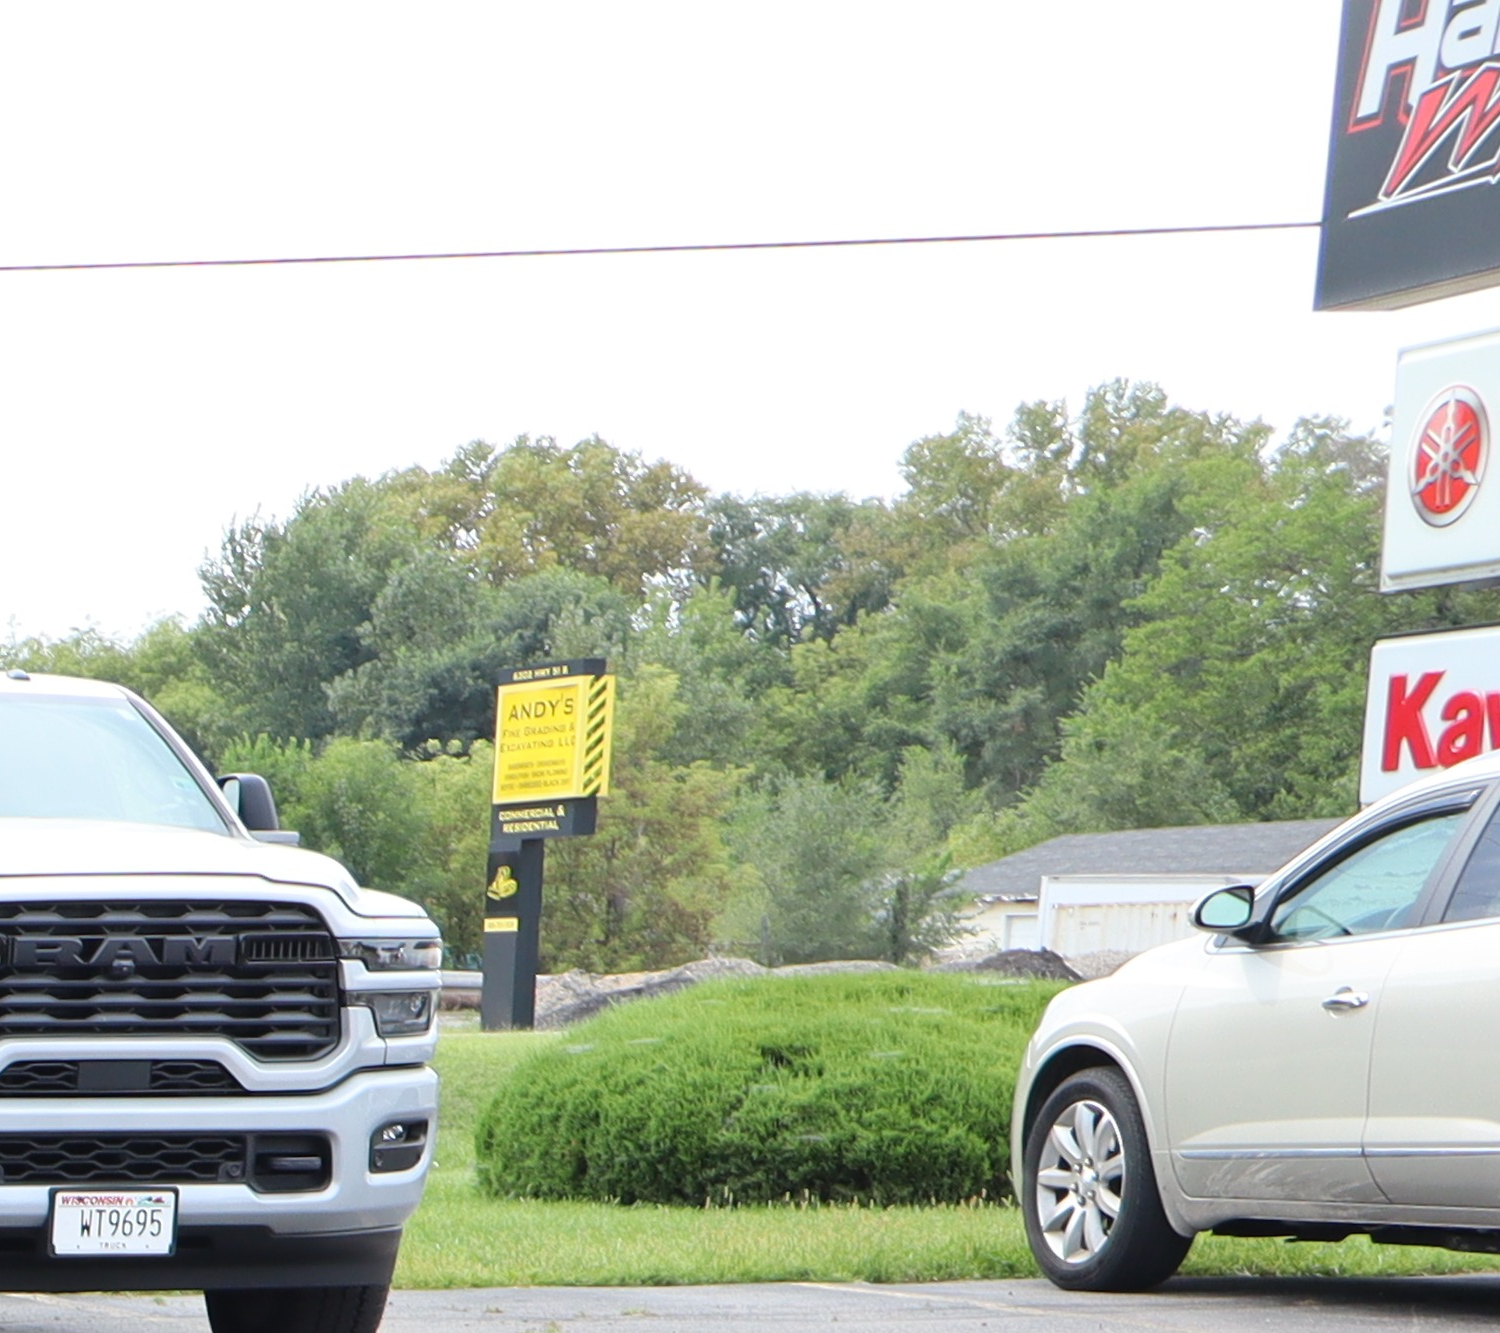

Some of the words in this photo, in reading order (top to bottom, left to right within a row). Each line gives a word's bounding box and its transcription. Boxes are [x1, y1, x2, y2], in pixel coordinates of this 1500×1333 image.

[1355, 0, 1500, 120] Ha
[508, 692, 574, 721] ANDY'S
[14, 936, 236, 966] RAM
[61, 1195, 124, 1207] WISCONSIN
[80, 1208, 163, 1238] WT9695
[99, 1241, 128, 1250] TRUCK
